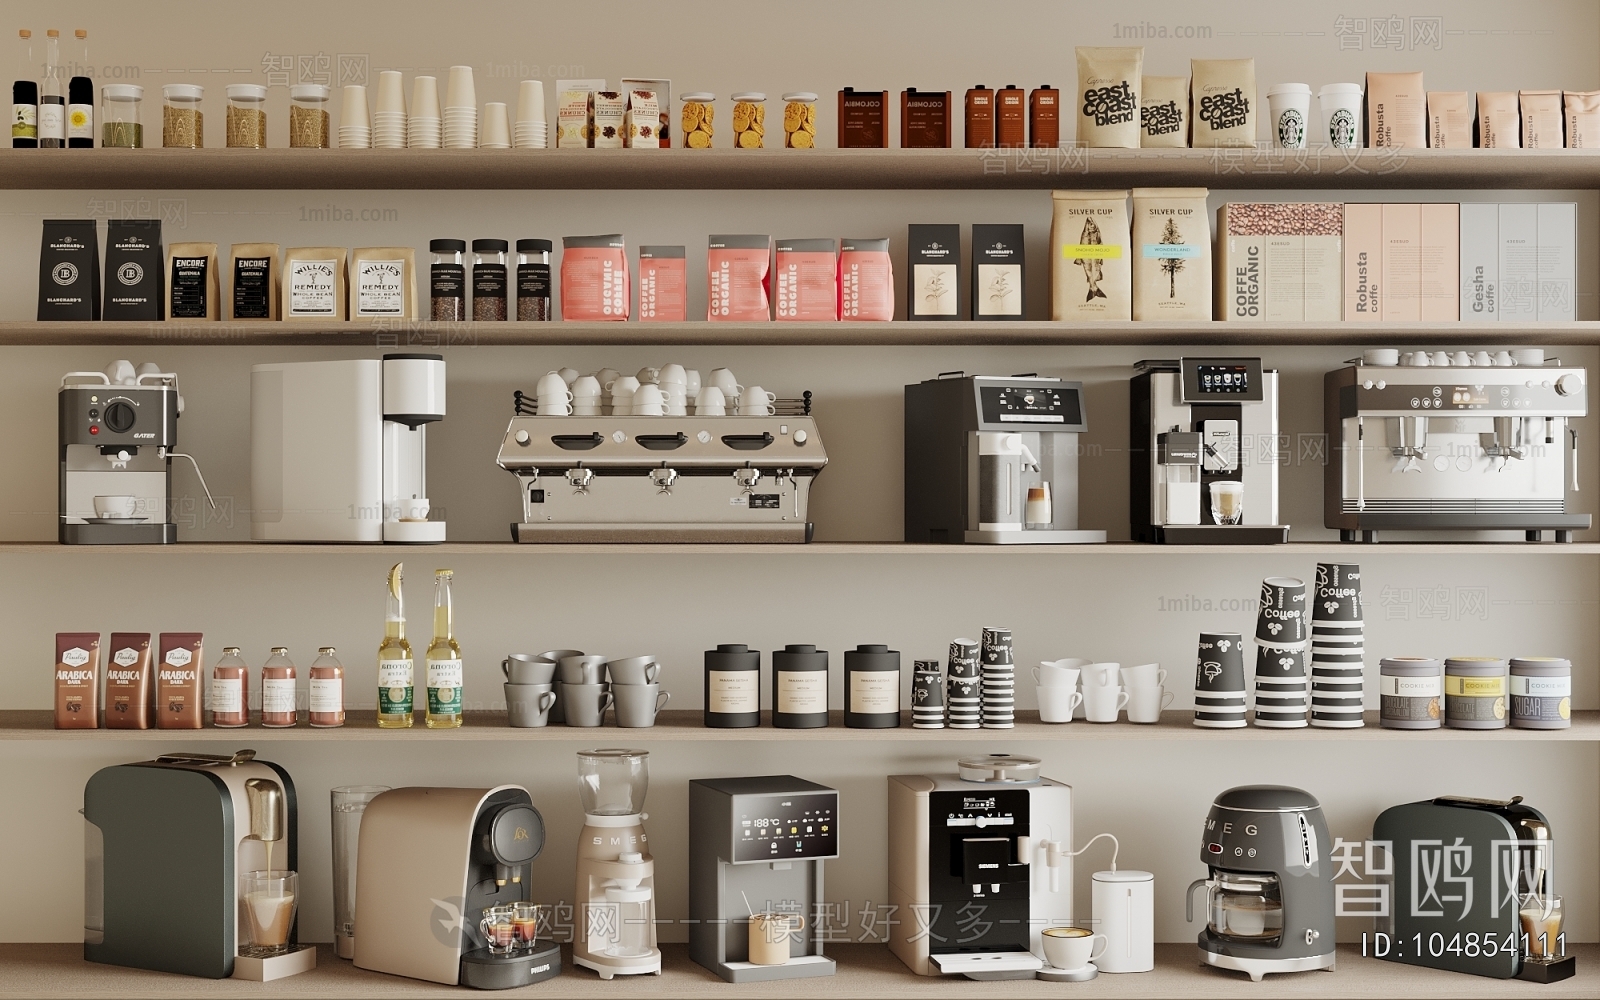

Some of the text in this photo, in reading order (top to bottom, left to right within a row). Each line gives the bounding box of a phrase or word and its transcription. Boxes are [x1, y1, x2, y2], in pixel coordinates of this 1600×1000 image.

[1084, 81, 1130, 102] east
[1200, 88, 1244, 109] east
[1083, 92, 1136, 116] coast
[1200, 98, 1250, 121] coast
[1095, 108, 1133, 126] blend
[1210, 113, 1246, 130] blend
[1376, 104, 1384, 147] Robusta
[1147, 121, 1179, 136] blend
[239, 260, 267, 268] ENCORE
[295, 265, 333, 276] WILLIE'S
[362, 265, 400, 276] WILLIE'S
[721, 261, 729, 316] ORGANIC
[789, 264, 797, 316] ORGANIC
[1236, 267, 1247, 316] COFFE
[1248, 246, 1258, 316] ORGANIC
[1356, 252, 1367, 313] Robusta
[1473, 266, 1484, 313] Gesha
[1369, 284, 1378, 313] coffe
[1486, 284, 1494, 313] coffe
[56, 670, 93, 680] ARABICA
[107, 670, 140, 680] ARABICA
[159, 670, 195, 680] ARABICA
[1514, 697, 1540, 716] SUGAR
[593, 834, 647, 846] SMEG
[531, 964, 550, 974] PHILIPS
